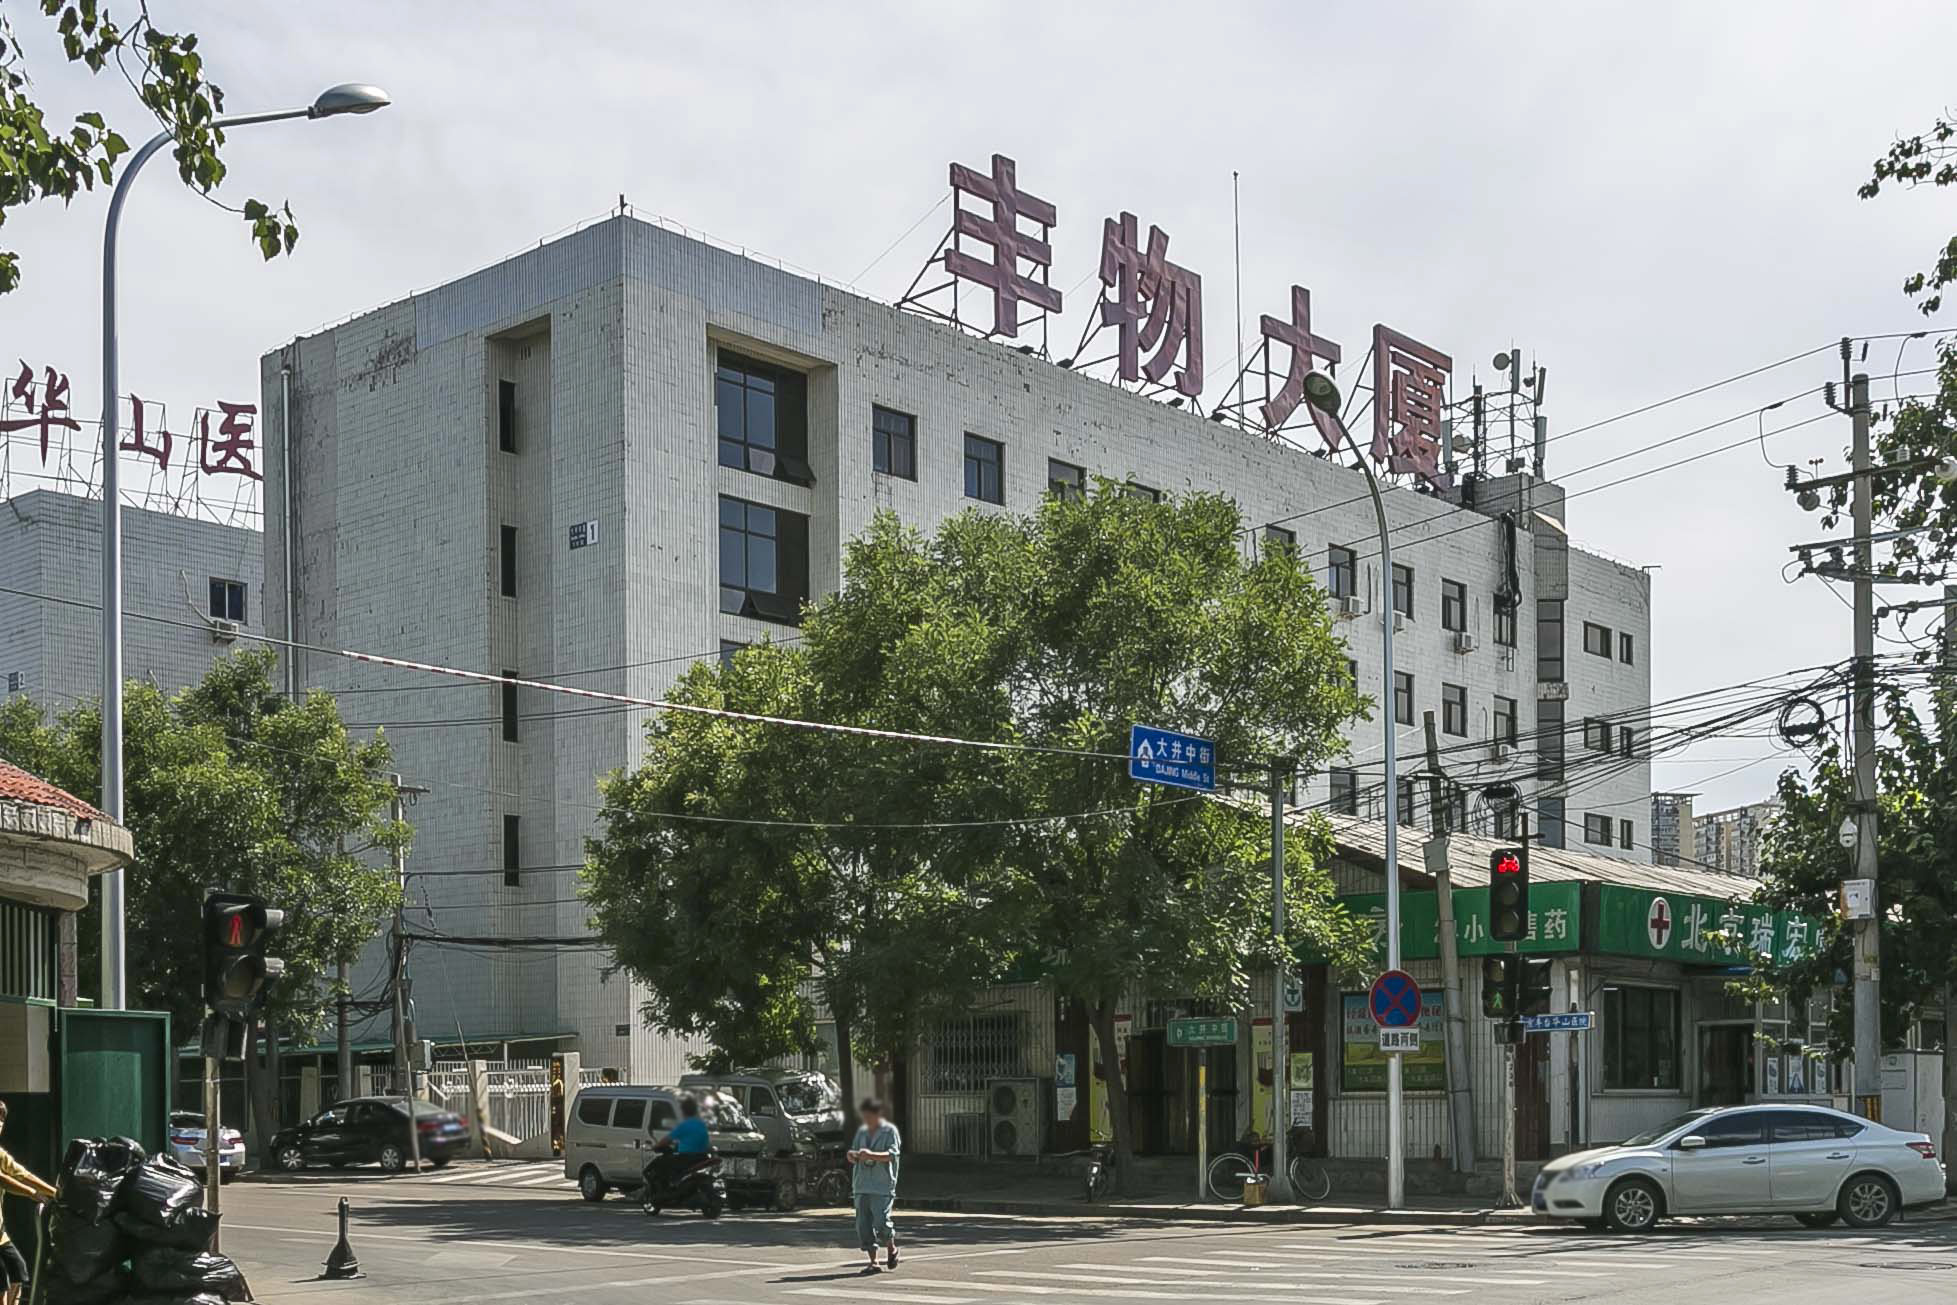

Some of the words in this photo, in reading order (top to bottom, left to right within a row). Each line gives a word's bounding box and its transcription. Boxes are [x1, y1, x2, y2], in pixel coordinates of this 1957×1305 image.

[944, 154, 1454, 494] 丰物大厦
[0, 358, 264, 482] 华山医
[1156, 737, 1210, 764] 大井中街
